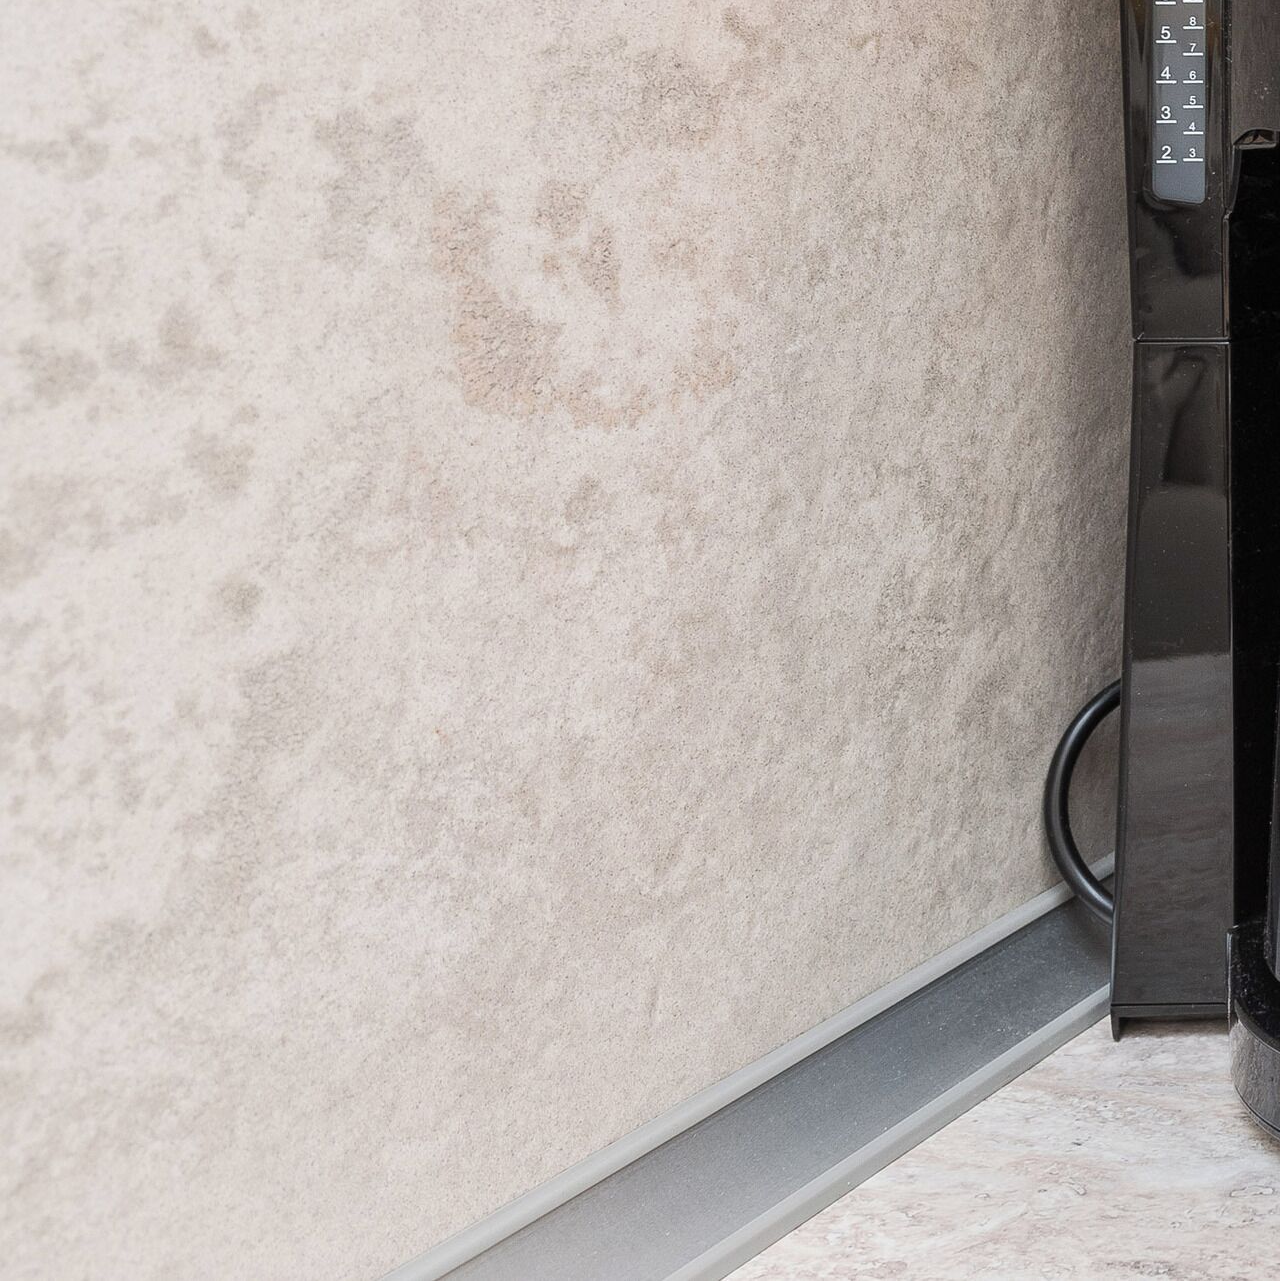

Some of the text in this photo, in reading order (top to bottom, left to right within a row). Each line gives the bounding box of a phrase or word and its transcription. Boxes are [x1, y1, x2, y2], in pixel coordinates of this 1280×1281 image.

[1189, 16, 1197, 26] 8
[1160, 25, 1171, 40] 5
[1189, 42, 1197, 52] 7
[1160, 65, 1172, 80] 4
[1189, 70, 1197, 80] 6
[1189, 95, 1197, 105] 5
[1160, 105, 1172, 120] 3
[1188, 121, 1196, 132] 4
[1161, 145, 1172, 160] 2
[1189, 147, 1196, 158] 3
